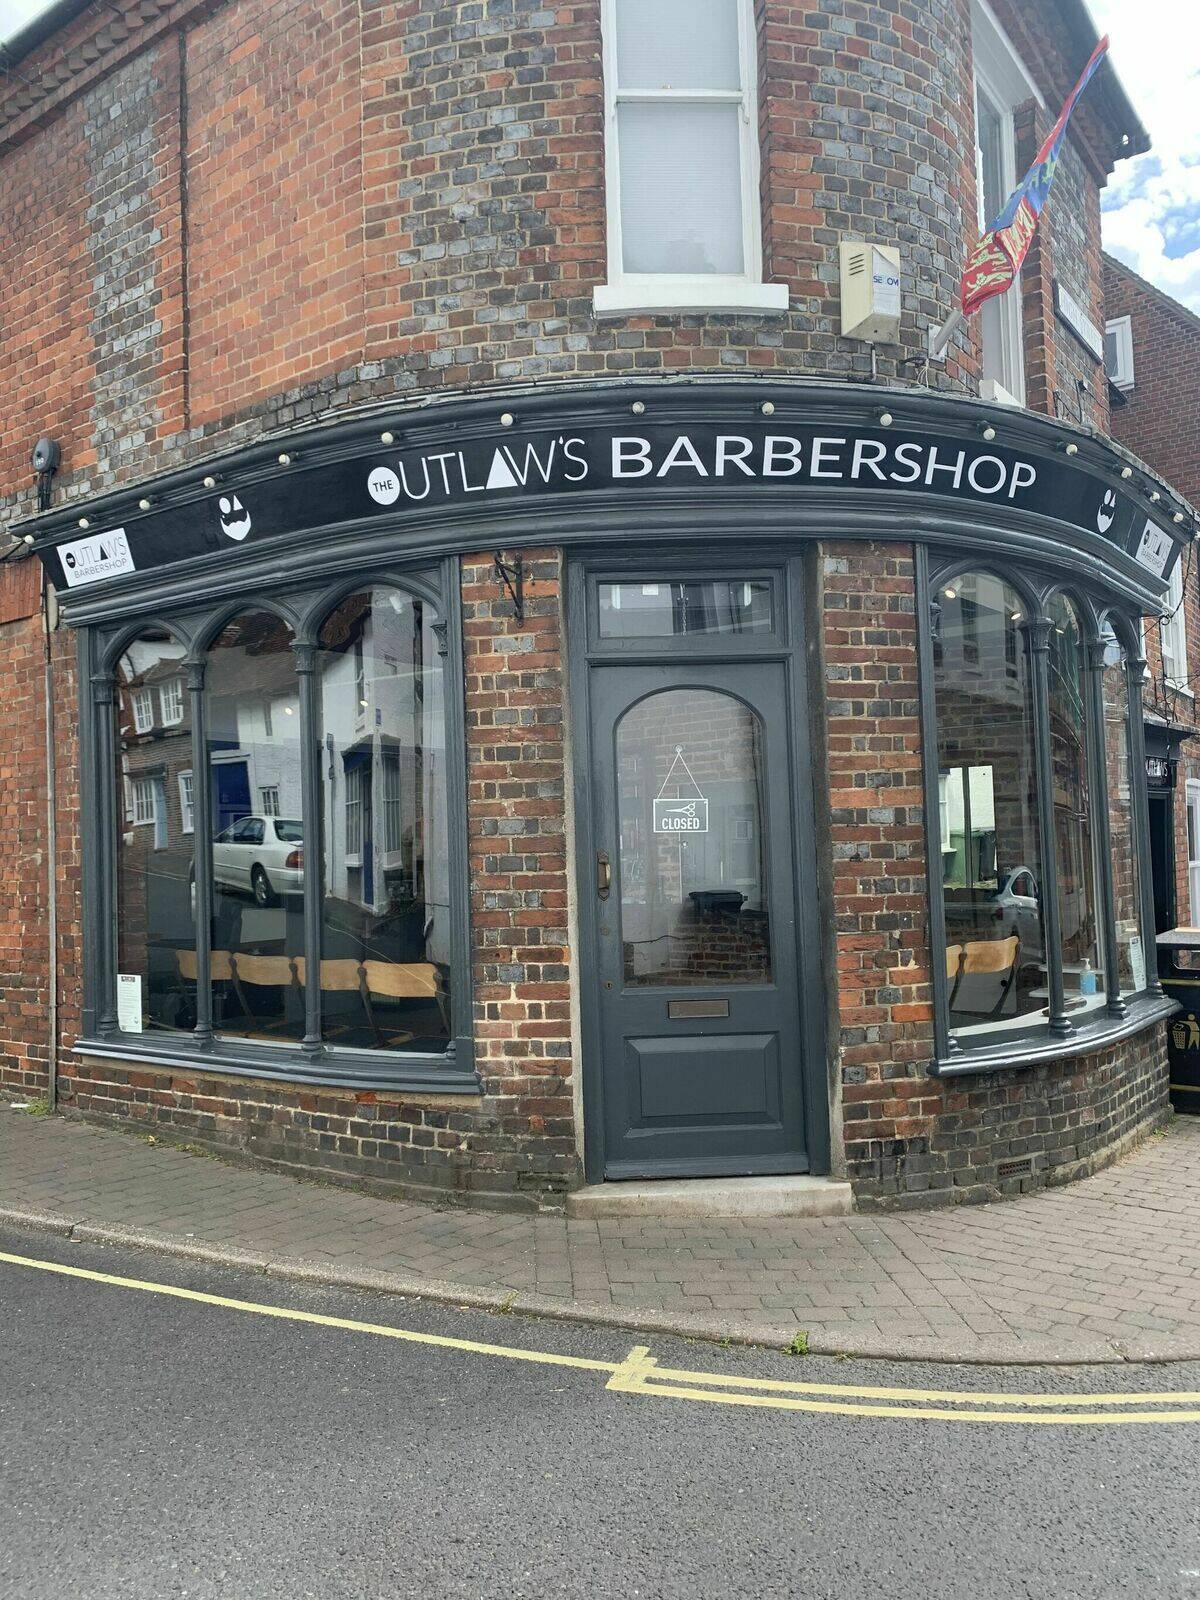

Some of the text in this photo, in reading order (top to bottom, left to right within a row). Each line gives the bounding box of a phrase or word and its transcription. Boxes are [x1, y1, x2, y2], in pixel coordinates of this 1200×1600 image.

[873, 275, 899, 287] SEOM
[372, 479, 394, 493] THE
[611, 435, 1037, 498] BARBERSHOP
[74, 558, 128, 578] BARBERSHOP
[661, 817, 700, 830] CLOSED
